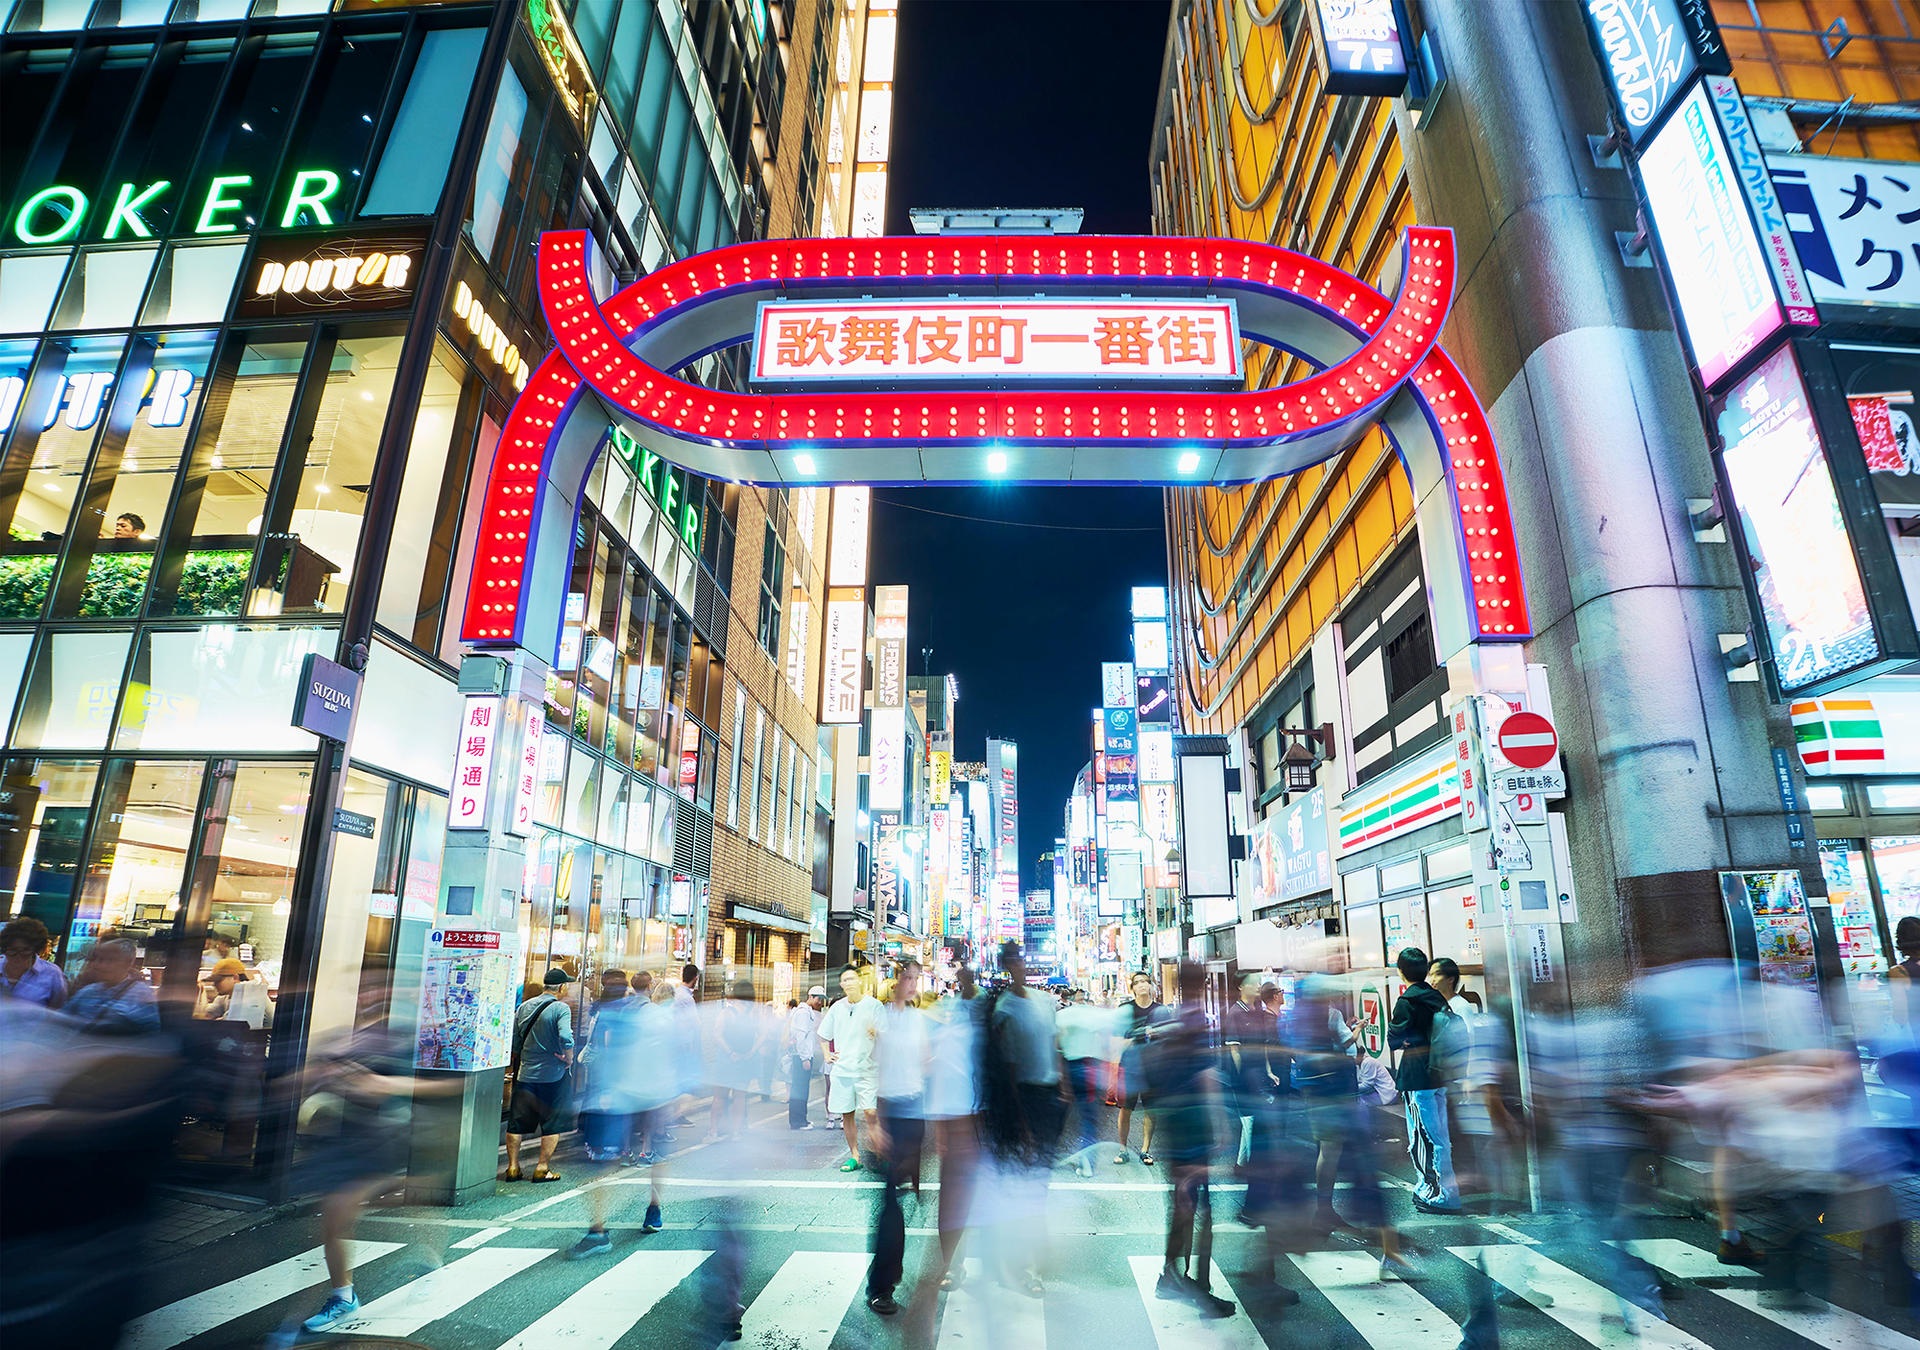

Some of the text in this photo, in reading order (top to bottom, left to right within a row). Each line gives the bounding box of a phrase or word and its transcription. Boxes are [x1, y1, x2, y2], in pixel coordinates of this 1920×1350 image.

[1337, 41, 1393, 71] 7F
[14, 169, 341, 245] OKER
[256, 252, 412, 296] DOUTOR
[453, 280, 530, 394] DOUTOR
[776, 315, 1216, 367] 歌舞伎町一番街
[853, 589, 862, 600] 3
[840, 648, 857, 712] LIVE
[885, 649, 900, 706] FRIDAYS
[312, 681, 352, 710] SUZUYA
[324, 701, 339, 714] BLDG
[461, 706, 492, 817] 劇場通り
[519, 716, 541, 823] 劇場通り
[1456, 710, 1477, 820] 劇場通り
[1507, 775, 1561, 791] 自転車を除く
[339, 812, 360, 825] SUZUYA
[881, 814, 898, 825] TGI
[1002, 767, 1019, 846] HUMAX
[1311, 789, 1324, 820] 2F
[338, 822, 367, 834] ENTRANCE
[1789, 823, 1801, 834] 17
[1287, 850, 1312, 876] WAGYU
[1286, 870, 1317, 895] SUKIYAKI
